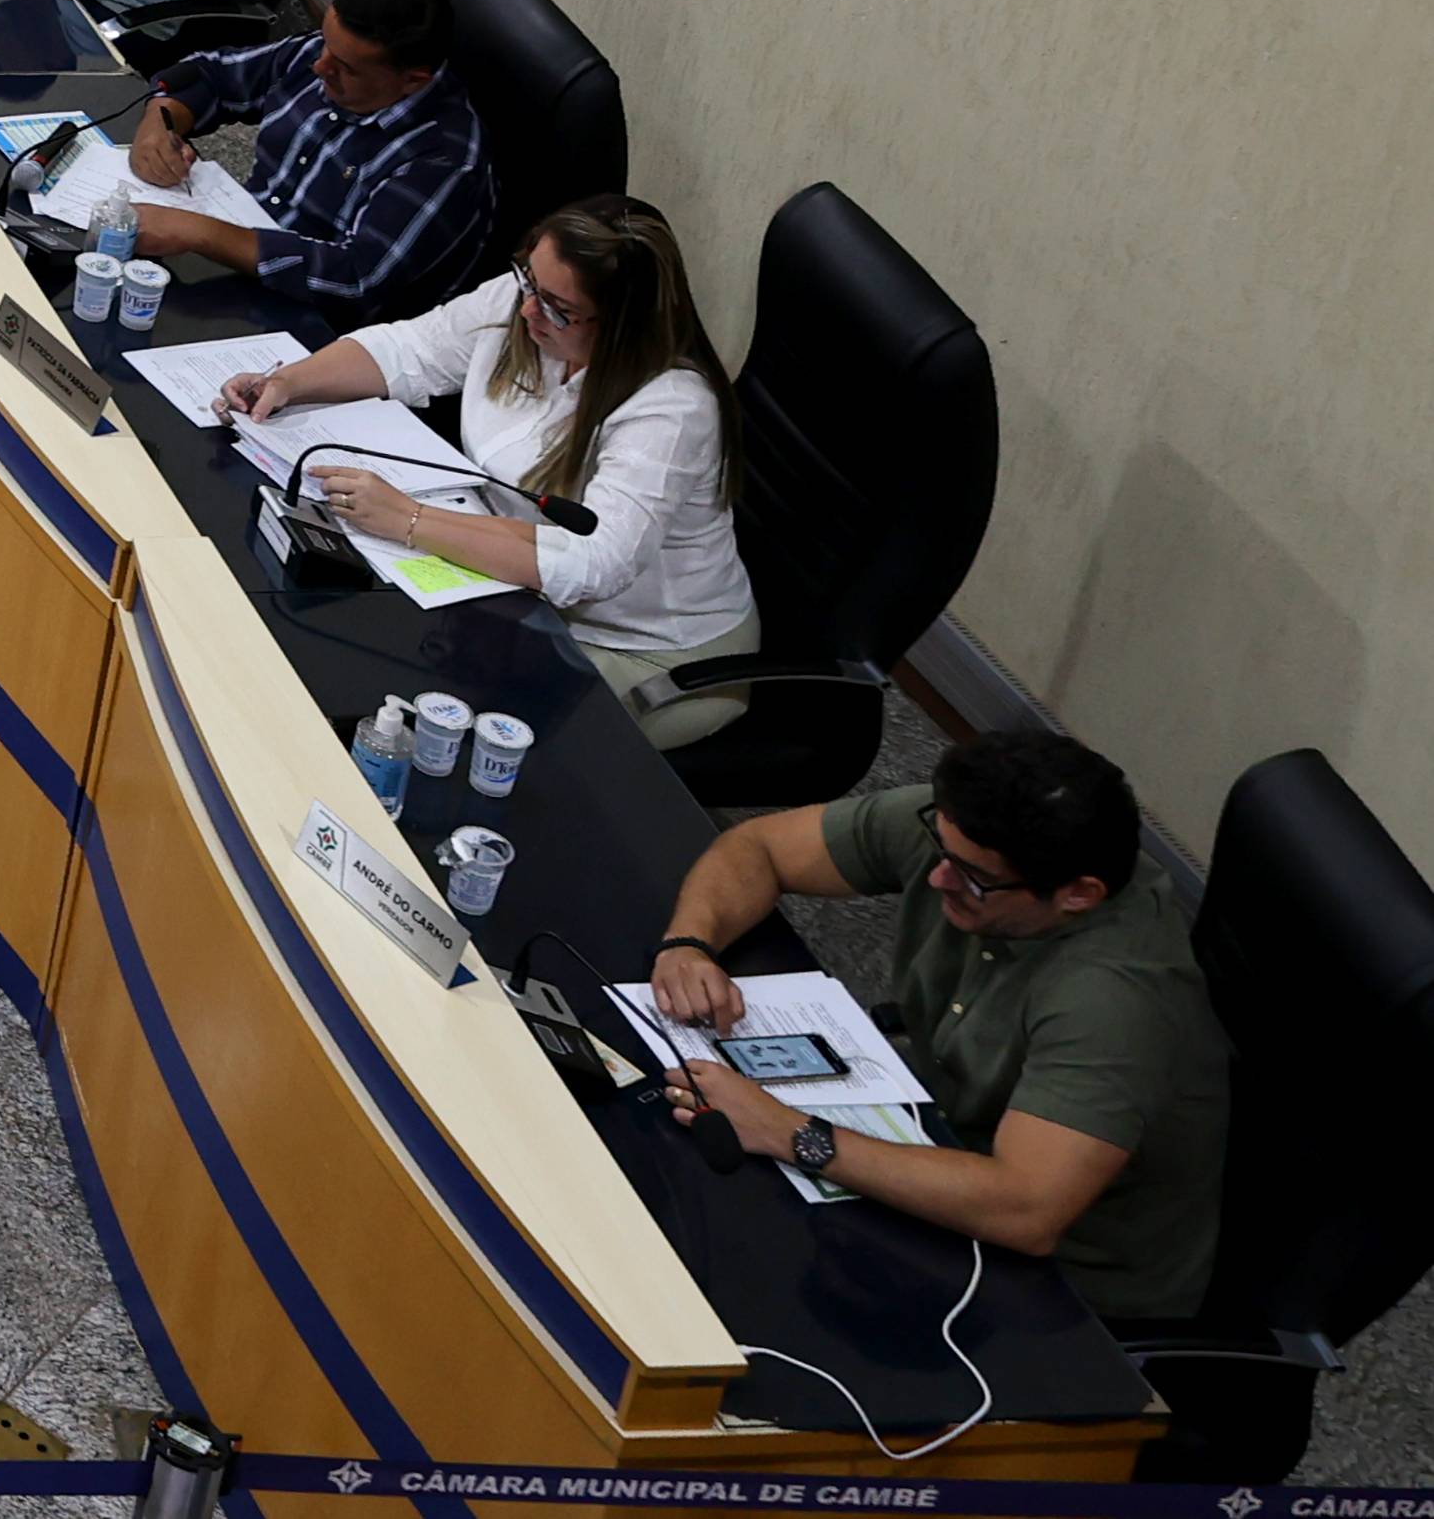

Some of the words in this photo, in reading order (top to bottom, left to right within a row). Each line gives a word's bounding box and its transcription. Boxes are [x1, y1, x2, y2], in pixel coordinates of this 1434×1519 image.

[67, 370, 100, 405] FARMÁCIA
[306, 845, 333, 872] CAMBÉ
[352, 860, 393, 897] ANDRÉ
[393, 893, 411, 913] DO
[411, 910, 453, 950] CARMO
[378, 900, 415, 936] VEREADOR
[400, 1470, 546, 1496] CÂMARA
[557, 1478, 747, 1502] MUNICIPAL
[759, 1483, 804, 1504] DE
[816, 1484, 940, 1508] CAMBÉ
[1291, 1494, 1434, 1517] CÂMARA
